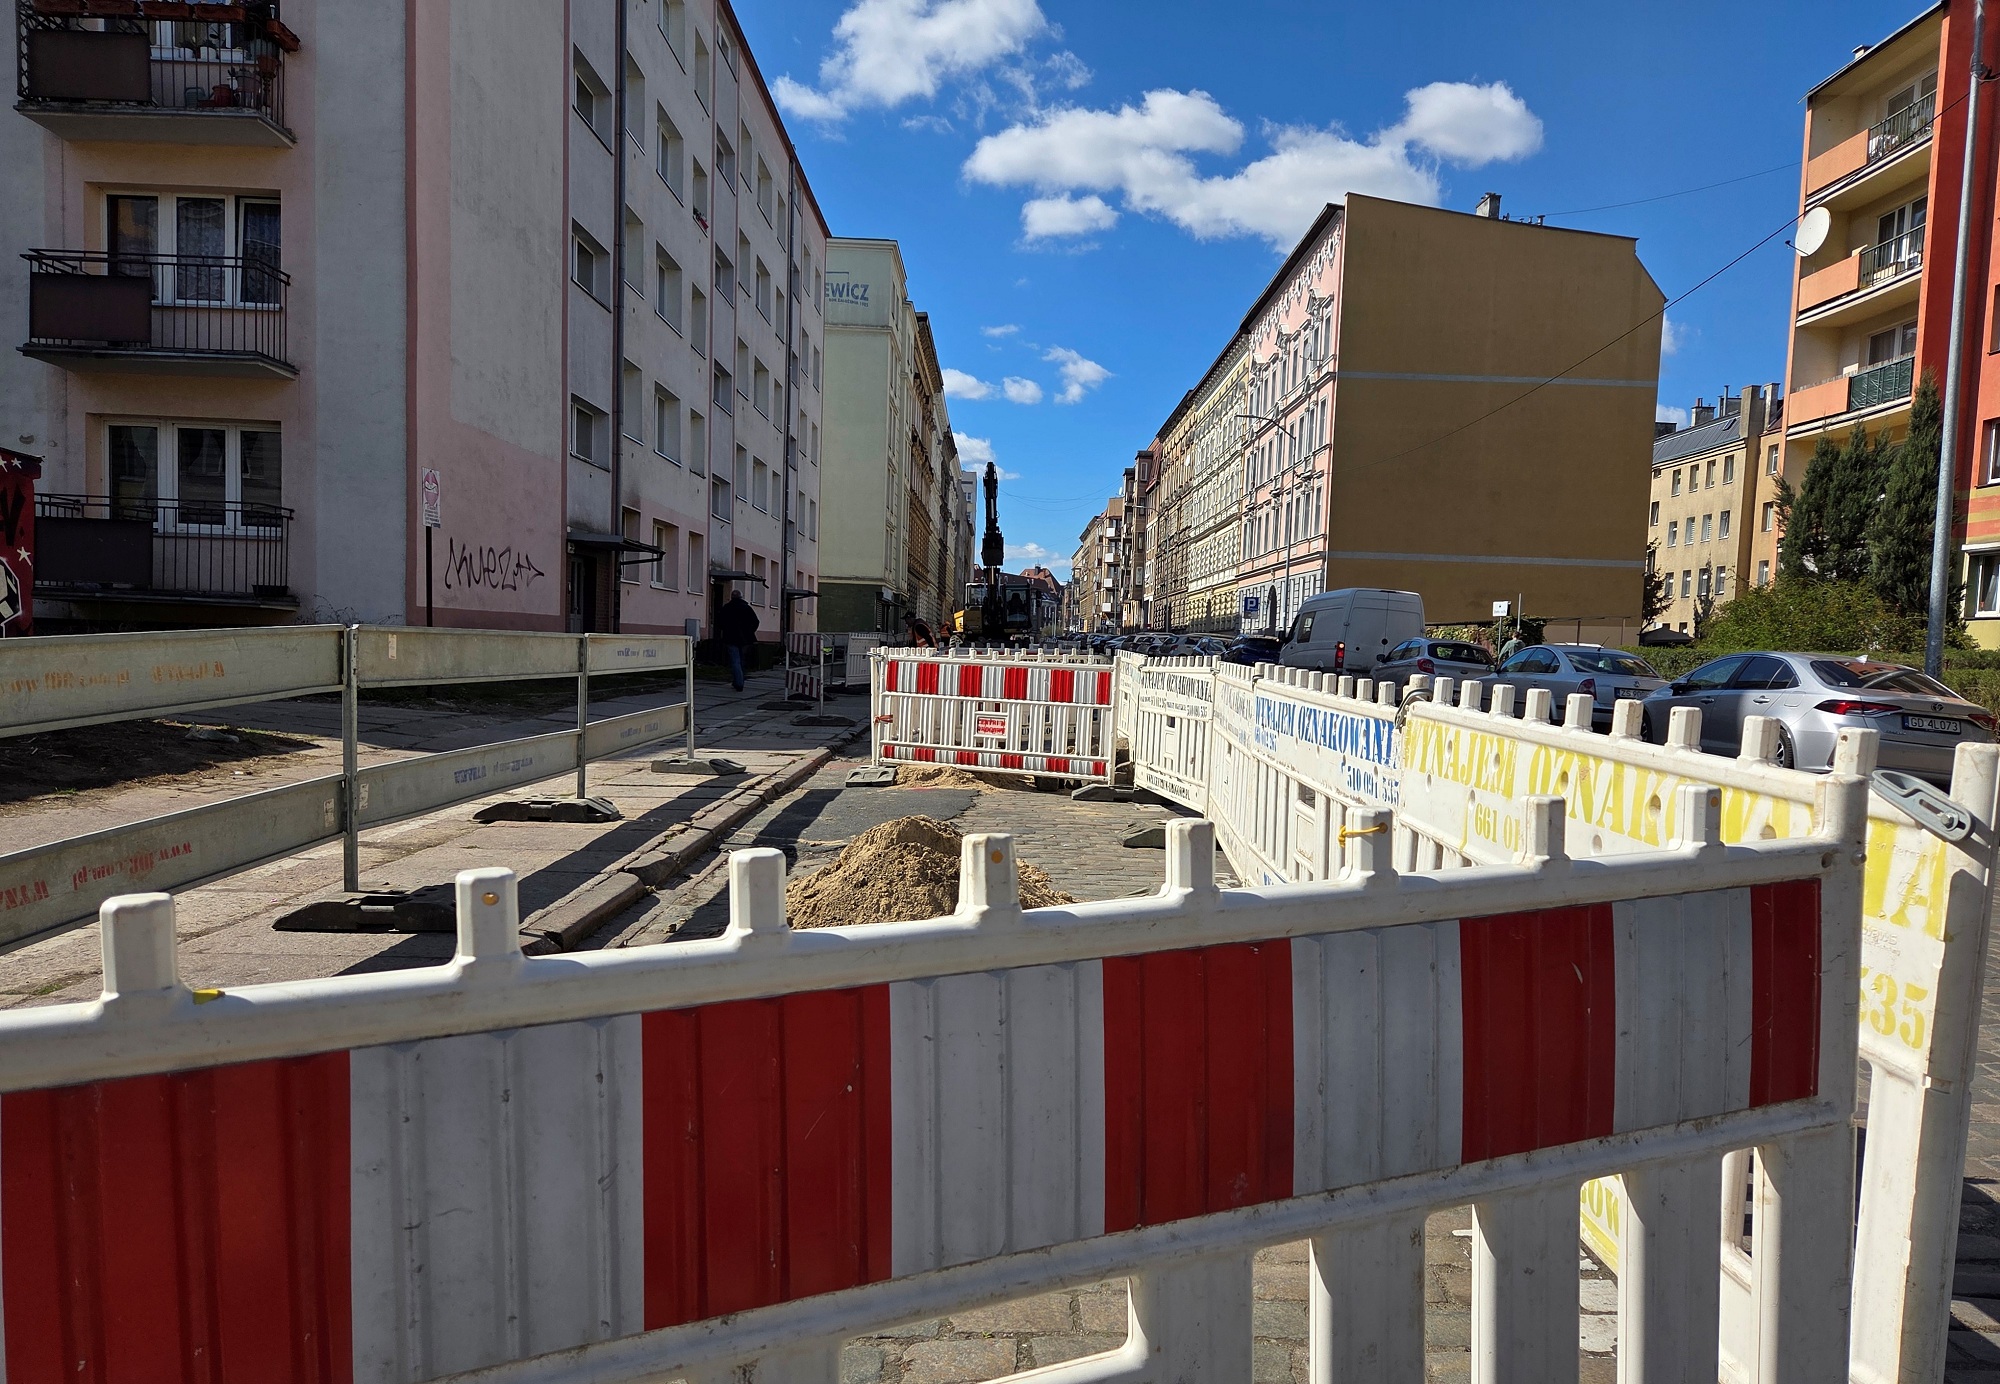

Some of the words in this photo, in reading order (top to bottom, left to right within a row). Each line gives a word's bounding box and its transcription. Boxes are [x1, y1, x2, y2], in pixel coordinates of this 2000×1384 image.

[1166, 674, 1213, 703] OZNAKOWANIA
[1255, 696, 1296, 737] WYNAJEM
[1910, 717, 1924, 727] GD
[1927, 719, 1958, 731] 4L073
[1405, 719, 1517, 800] WYNAJEM
[1347, 765, 1361, 791] 510
[1475, 802, 1498, 843] 661
[1503, 814, 1521, 853] 01
